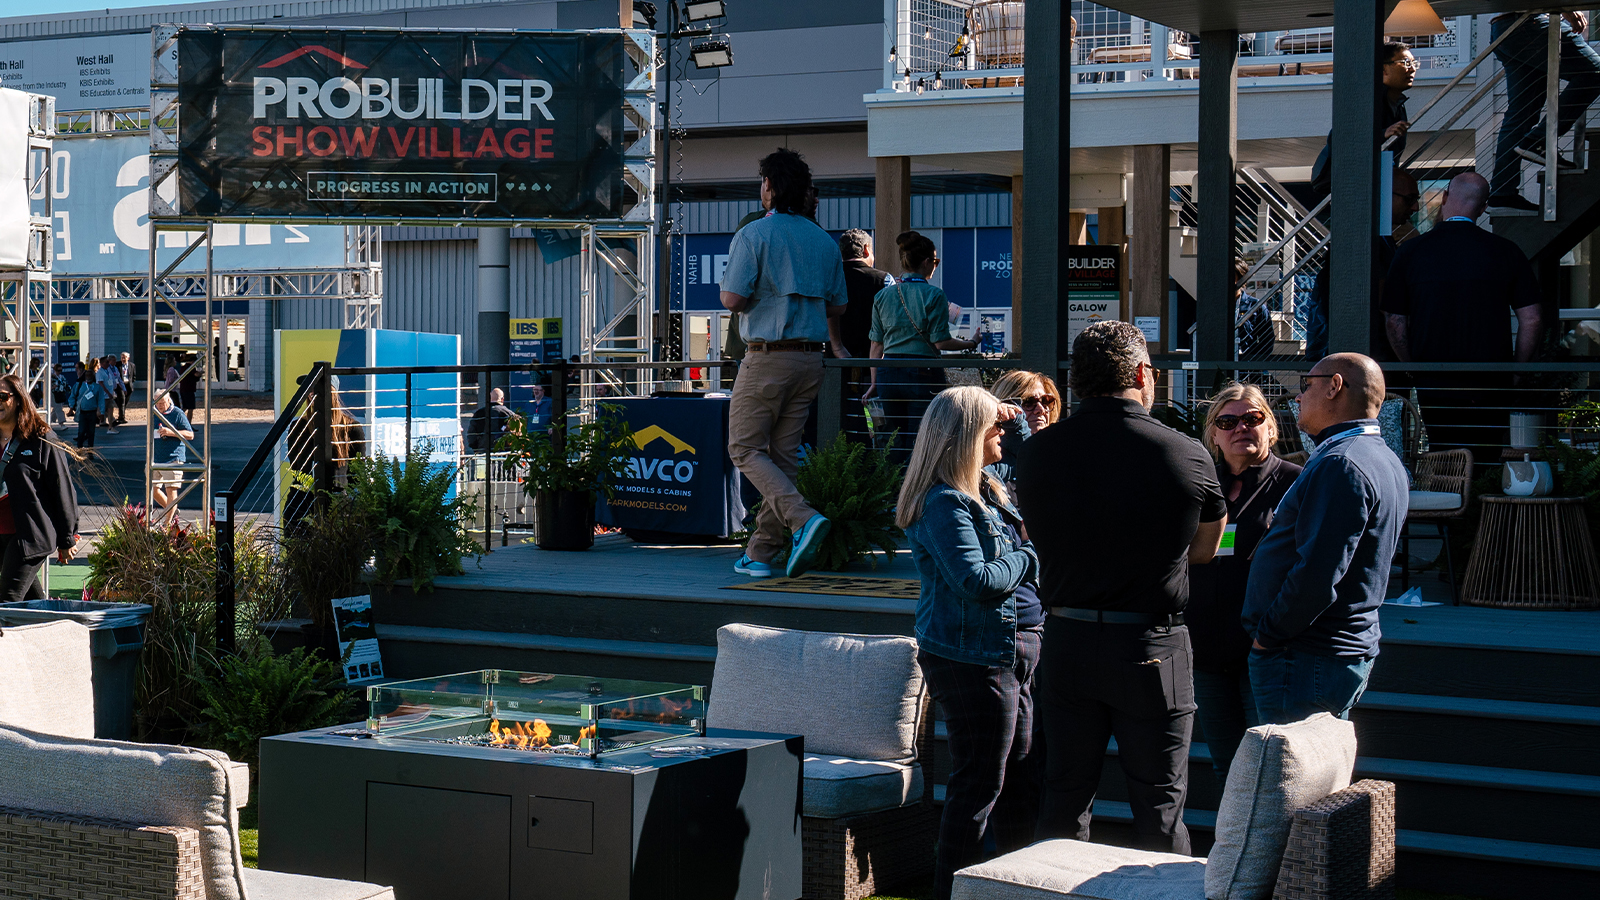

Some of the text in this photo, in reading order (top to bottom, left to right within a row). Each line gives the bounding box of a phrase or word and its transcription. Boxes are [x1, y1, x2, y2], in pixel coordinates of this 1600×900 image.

[10, 60, 24, 70] Hall
[76, 54, 114, 66] West Hall
[90, 68, 111, 76] Exhibits
[46, 81, 67, 89] Industry
[80, 78, 115, 87] KBIS Exhibits
[90, 88, 116, 98] Education
[253, 76, 555, 121] PROBUILDER
[252, 125, 555, 159] SHOW VILLAGE
[317, 180, 489, 195] PROGRESS IN ACTION
[688, 254, 698, 285] NAHB
[1068, 258, 1115, 269] BUILDER
[1074, 270, 1116, 278] VILLAGE
[62, 325, 76, 336] IBS
[516, 322, 538, 335] IBS
[547, 322, 559, 334] IBS
[992, 317, 1002, 346] MiTek
[626, 486, 655, 494] MODELS
[664, 488, 692, 498] CABINS
[606, 498, 688, 512] PARKMODELS.COM
